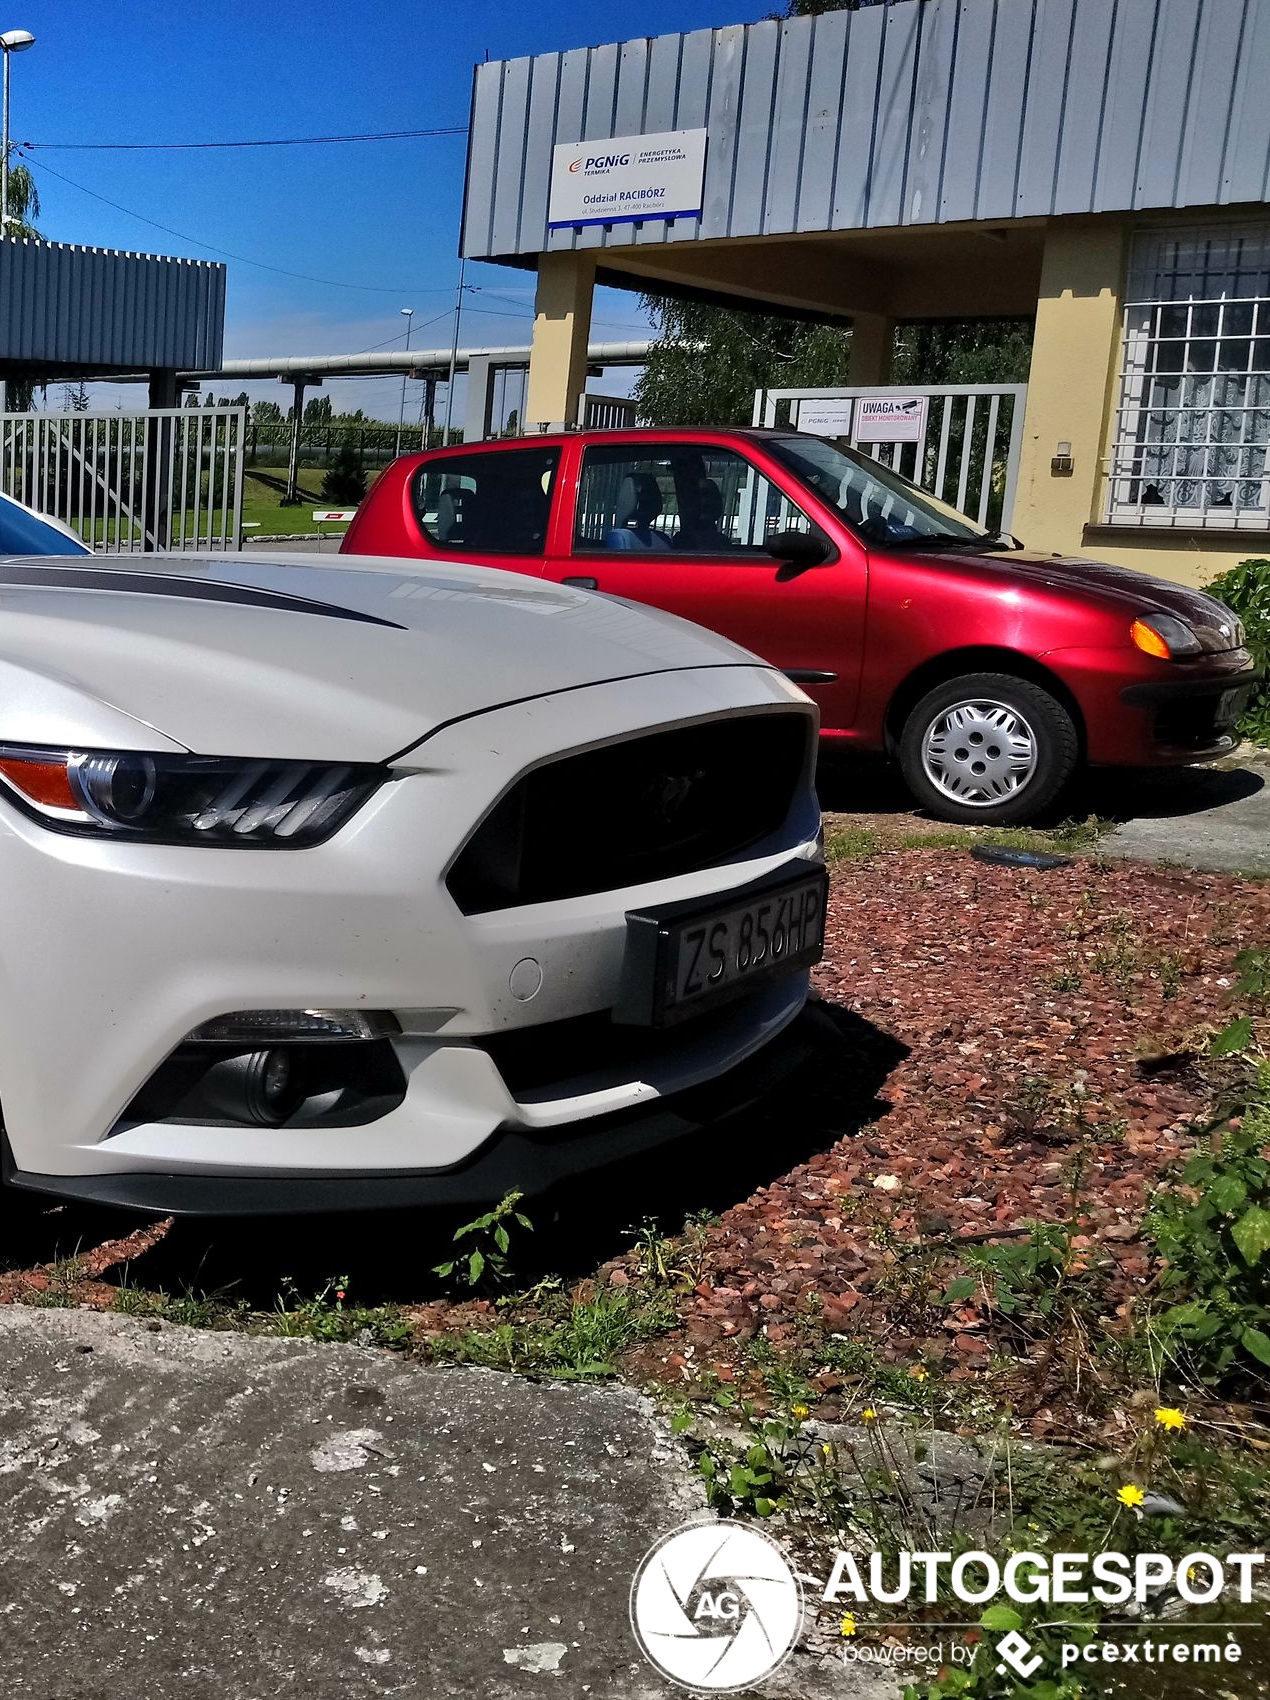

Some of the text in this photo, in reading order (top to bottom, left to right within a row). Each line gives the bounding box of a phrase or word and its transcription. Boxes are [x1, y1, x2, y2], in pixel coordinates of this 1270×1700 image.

[638, 154, 686, 164] PRZEMYSŁOWA
[639, 149, 681, 157] ENERGETYKA
[585, 154, 630, 169] PGNiG
[583, 187, 666, 204] Oddział RACIBÓRZ
[862, 402, 894, 414] UWAGA
[683, 888, 819, 996] ZS 856HP
